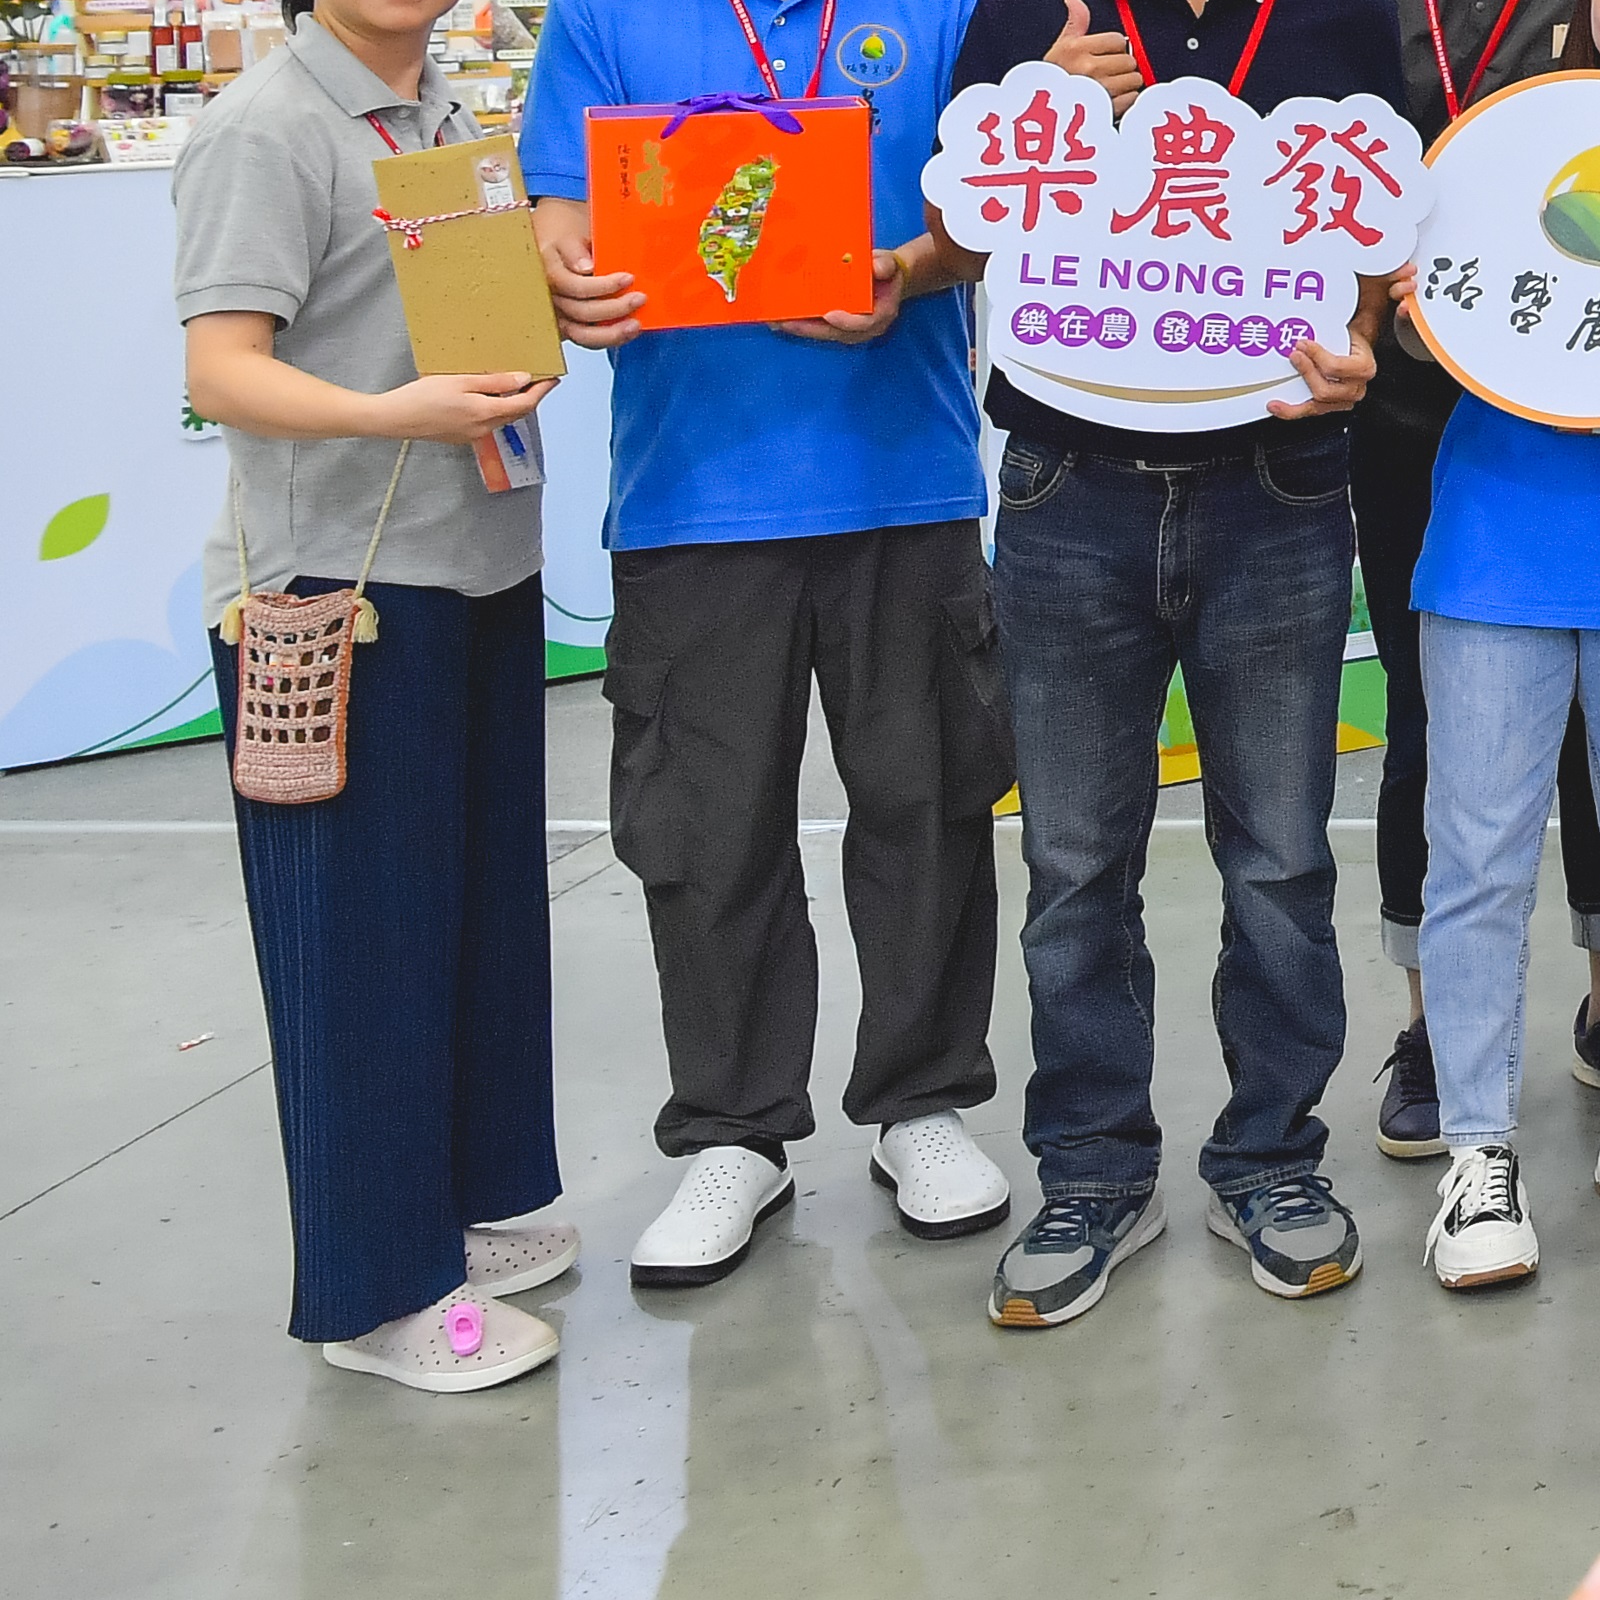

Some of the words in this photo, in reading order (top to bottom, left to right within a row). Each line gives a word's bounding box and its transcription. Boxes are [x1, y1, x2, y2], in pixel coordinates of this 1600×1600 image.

[961, 90, 1402, 247] 樂農發
[1019, 253, 1080, 287] LE
[1099, 257, 1244, 297] NONG
[1264, 269, 1325, 301] FA
[1015, 307, 1132, 345] 樂在農
